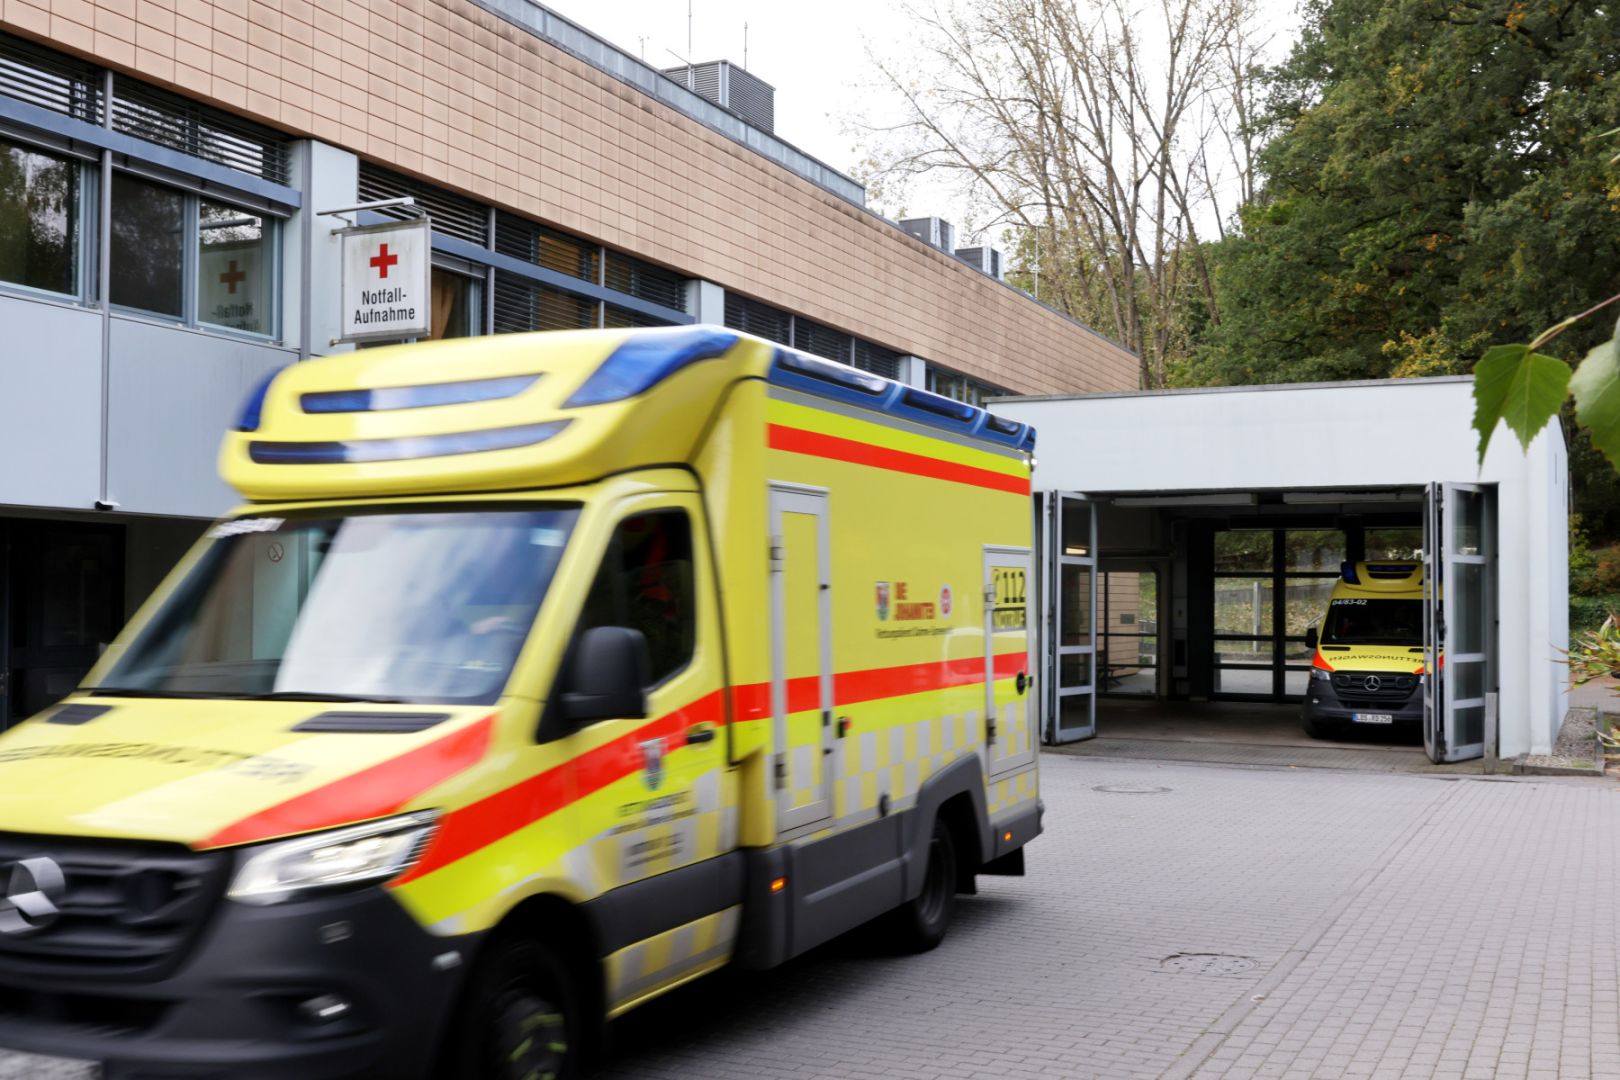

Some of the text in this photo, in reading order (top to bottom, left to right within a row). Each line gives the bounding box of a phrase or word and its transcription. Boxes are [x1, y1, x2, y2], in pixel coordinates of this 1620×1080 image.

[362, 288, 407, 305] Notfall-
[354, 307, 415, 324] Aufnahme
[1003, 571, 1025, 604] 112
